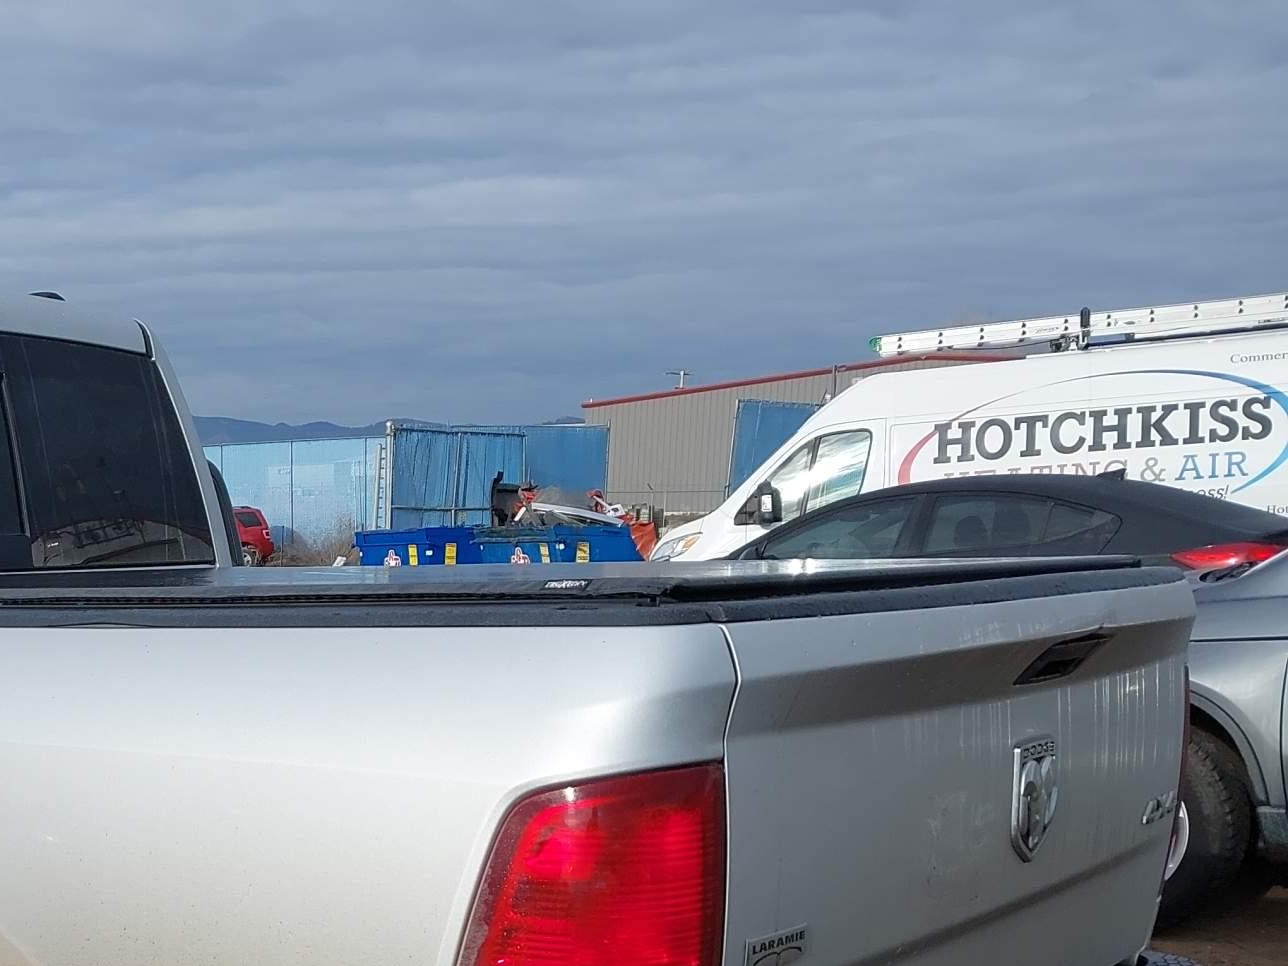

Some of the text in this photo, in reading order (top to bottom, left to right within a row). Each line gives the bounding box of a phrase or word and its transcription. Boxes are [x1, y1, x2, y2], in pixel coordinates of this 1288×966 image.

[933, 396, 1273, 464] HOTCHKISS
[1140, 457, 1165, 481] &
[1175, 452, 1248, 480] AIR
[1023, 740, 1056, 760] DODGE
[752, 930, 806, 955] LARAMIE
